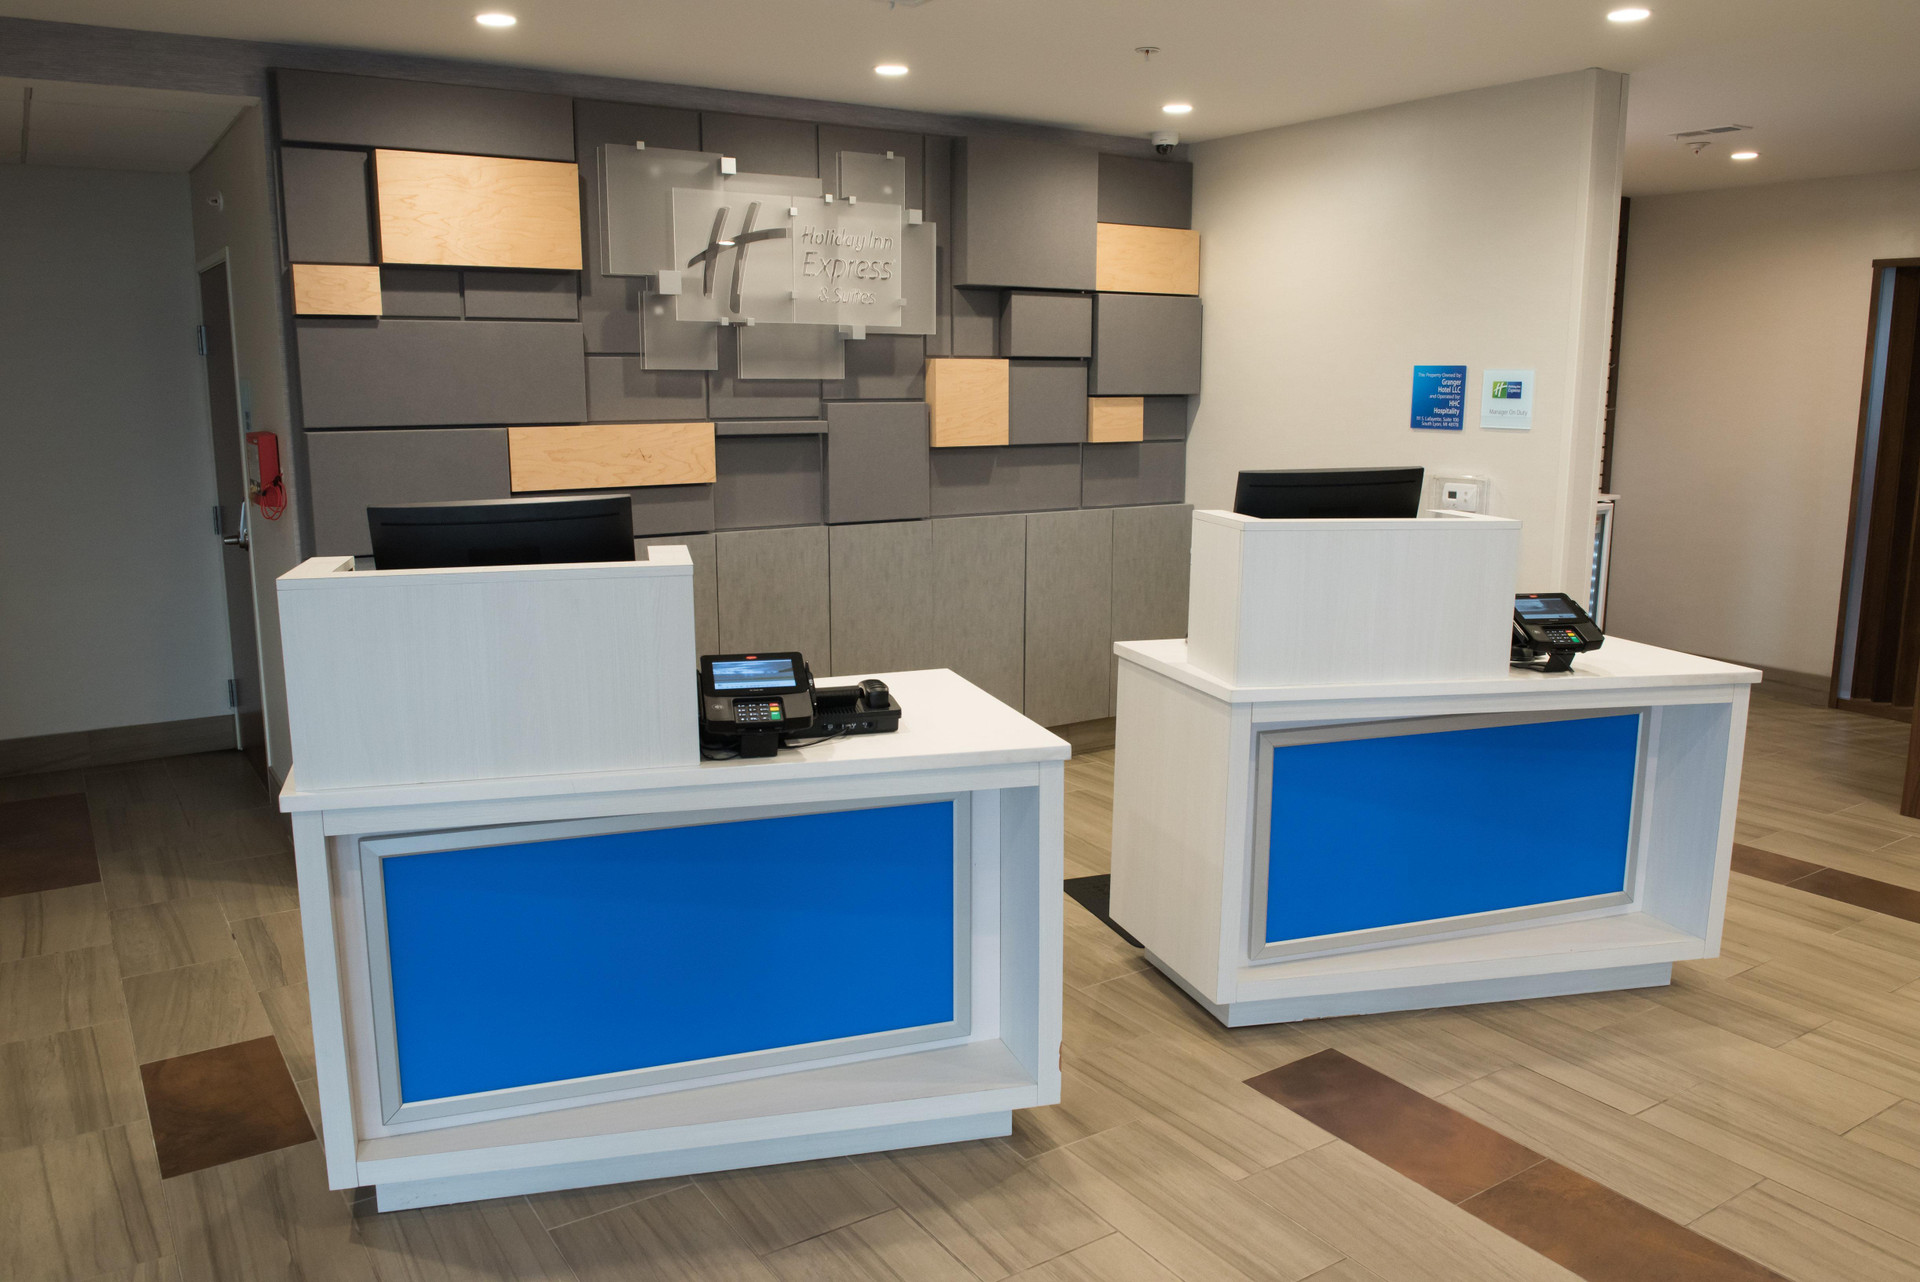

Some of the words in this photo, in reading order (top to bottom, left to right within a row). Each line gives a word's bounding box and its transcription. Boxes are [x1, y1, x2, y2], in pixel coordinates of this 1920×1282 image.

[801, 225, 866, 252] Holiday
[868, 230, 894, 250] Inn
[802, 251, 893, 285] Express
[818, 287, 829, 303] &
[832, 287, 877, 305] Suites
[1441, 378, 1462, 387] Granger
[1433, 407, 1460, 416] Hospitality
